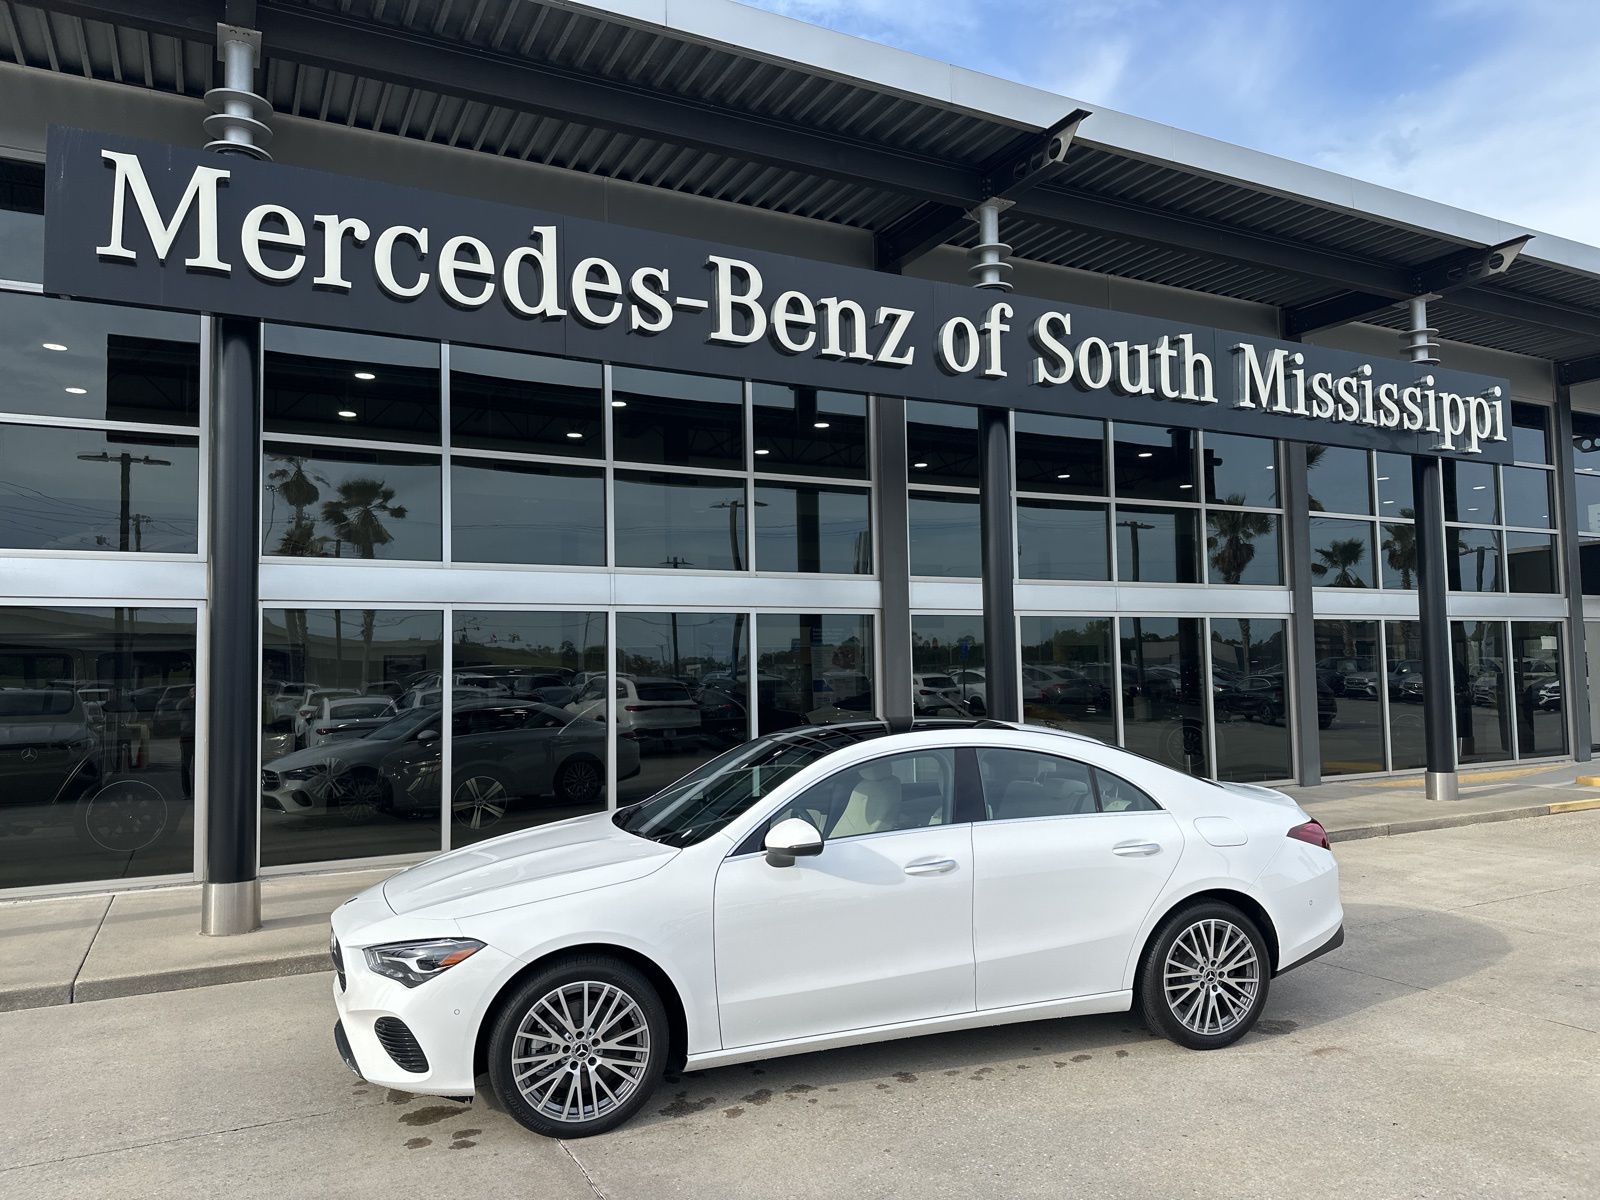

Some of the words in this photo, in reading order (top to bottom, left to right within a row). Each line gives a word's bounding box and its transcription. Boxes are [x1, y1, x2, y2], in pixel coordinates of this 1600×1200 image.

[96, 149, 915, 365] Mercedes-Benz
[940, 302, 1014, 377] of
[1034, 311, 1219, 404] South
[1235, 342, 1508, 454] Mississippi
